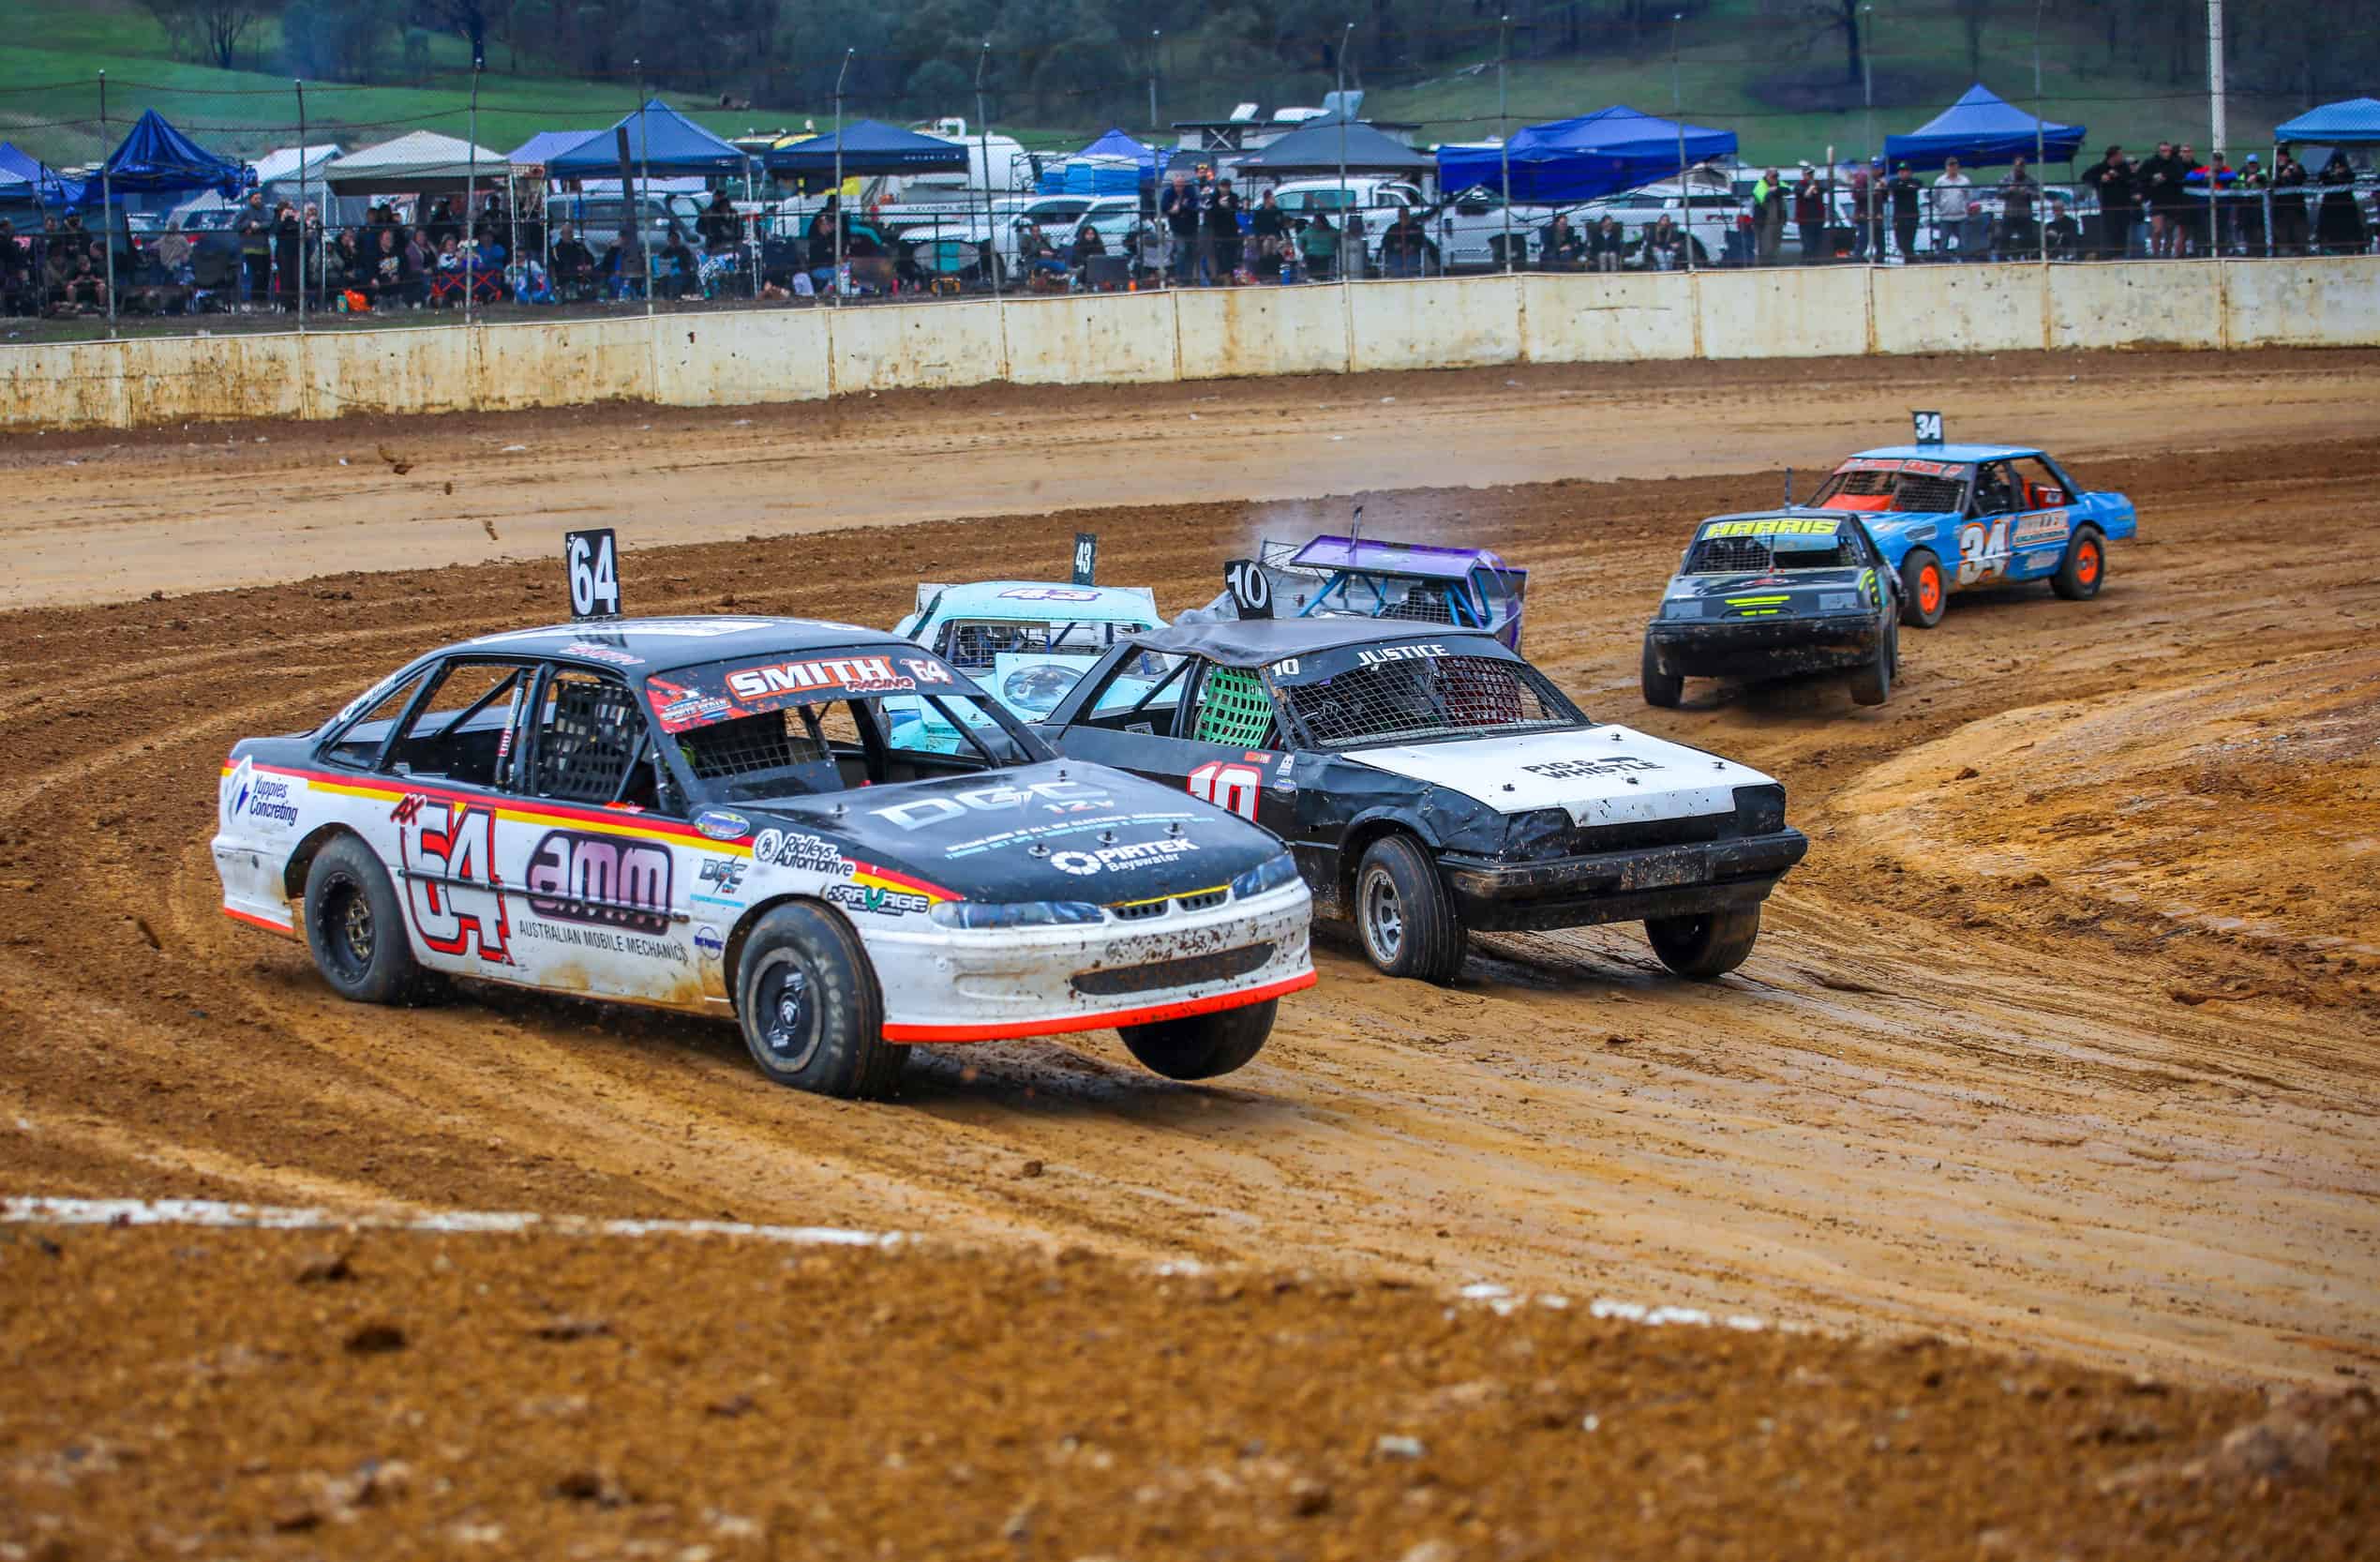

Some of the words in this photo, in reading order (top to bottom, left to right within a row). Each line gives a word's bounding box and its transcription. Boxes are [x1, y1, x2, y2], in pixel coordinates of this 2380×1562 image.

[1915, 413, 1942, 440] 34
[1704, 519, 1839, 539] HARRIS
[1074, 542, 1093, 575] 43
[1957, 517, 2012, 586] 34
[569, 535, 619, 616] 64
[1226, 563, 1268, 609] 10
[1271, 658, 1300, 676] 10
[1356, 643, 1451, 667] JUSTICE
[729, 658, 888, 698] SMITH
[909, 660, 951, 685] 64
[845, 676, 916, 692] RACING
[1539, 761, 1666, 779] WHISTLE
[252, 773, 289, 799] Yuppies
[1187, 760, 1262, 824] 10
[249, 795, 298, 826] Concreting
[390, 793, 427, 826] AX
[866, 781, 1108, 832] DGC
[772, 852, 854, 877] Automotive
[1094, 836, 1201, 864] PIRTEK
[1108, 851, 1180, 873] Bayswater
[399, 799, 516, 966] 64
[530, 834, 672, 910] amm
[699, 857, 748, 886] DGC
[839, 886, 929, 912] RAVAGE
[519, 919, 583, 944] AUSTRALIAN
[584, 930, 625, 953] MOBILE
[627, 938, 689, 962] MECHANICS
